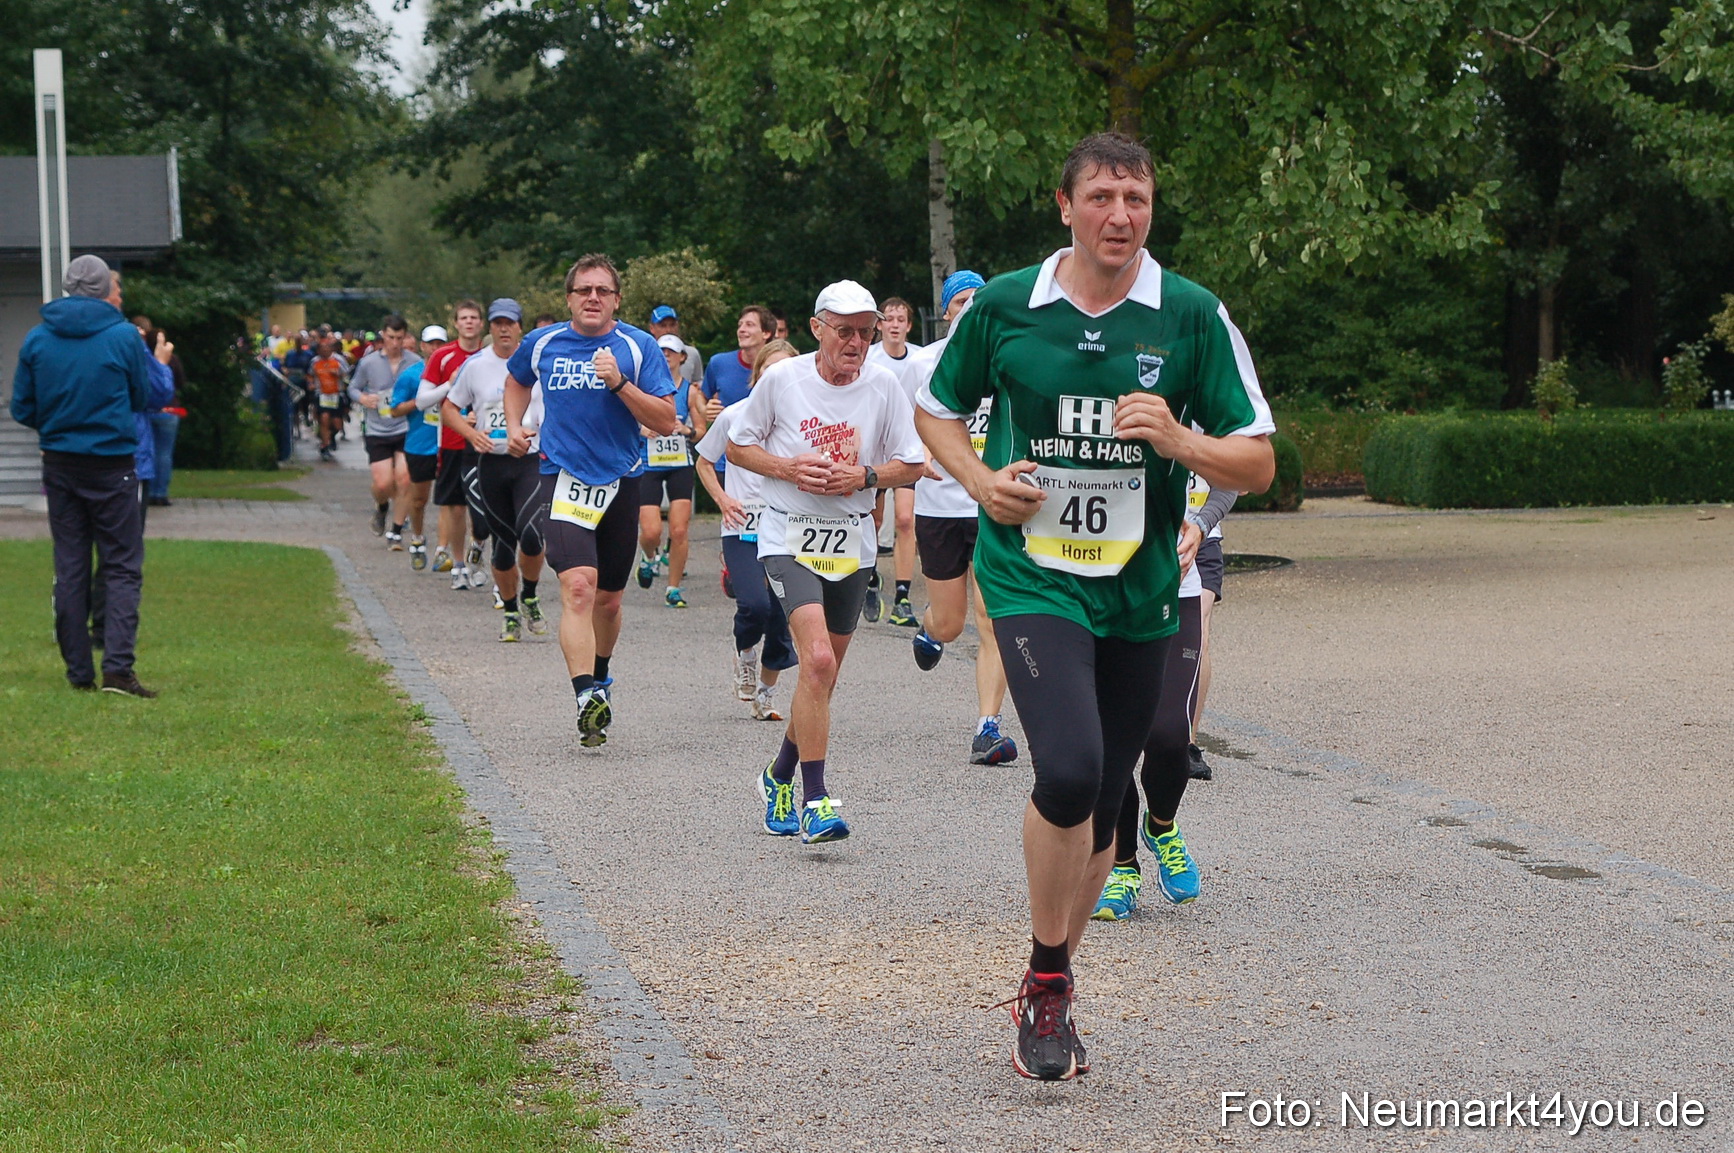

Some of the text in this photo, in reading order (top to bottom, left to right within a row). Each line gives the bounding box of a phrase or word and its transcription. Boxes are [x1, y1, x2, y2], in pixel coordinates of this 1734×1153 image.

[1078, 342, 1106, 352] erima
[548, 373, 607, 391] CORNE
[490, 412, 508, 428] 22
[800, 416, 823, 432] 20.
[804, 421, 848, 440] EGYPTIAN
[811, 428, 855, 448] MARATHON
[655, 439, 680, 453] 345
[1030, 437, 1143, 464] HEIM & HAUS
[1035, 476, 1123, 490] ARTL Neumarkt
[568, 482, 607, 508] 510
[571, 508, 593, 520] Josef
[788, 516, 850, 526] PARTL Neumarkt
[1059, 495, 1108, 535] 46
[801, 527, 848, 554] 272
[1061, 543, 1103, 561] Horst
[811, 560, 834, 571] Willi
[1021, 647, 1039, 678] odlo
